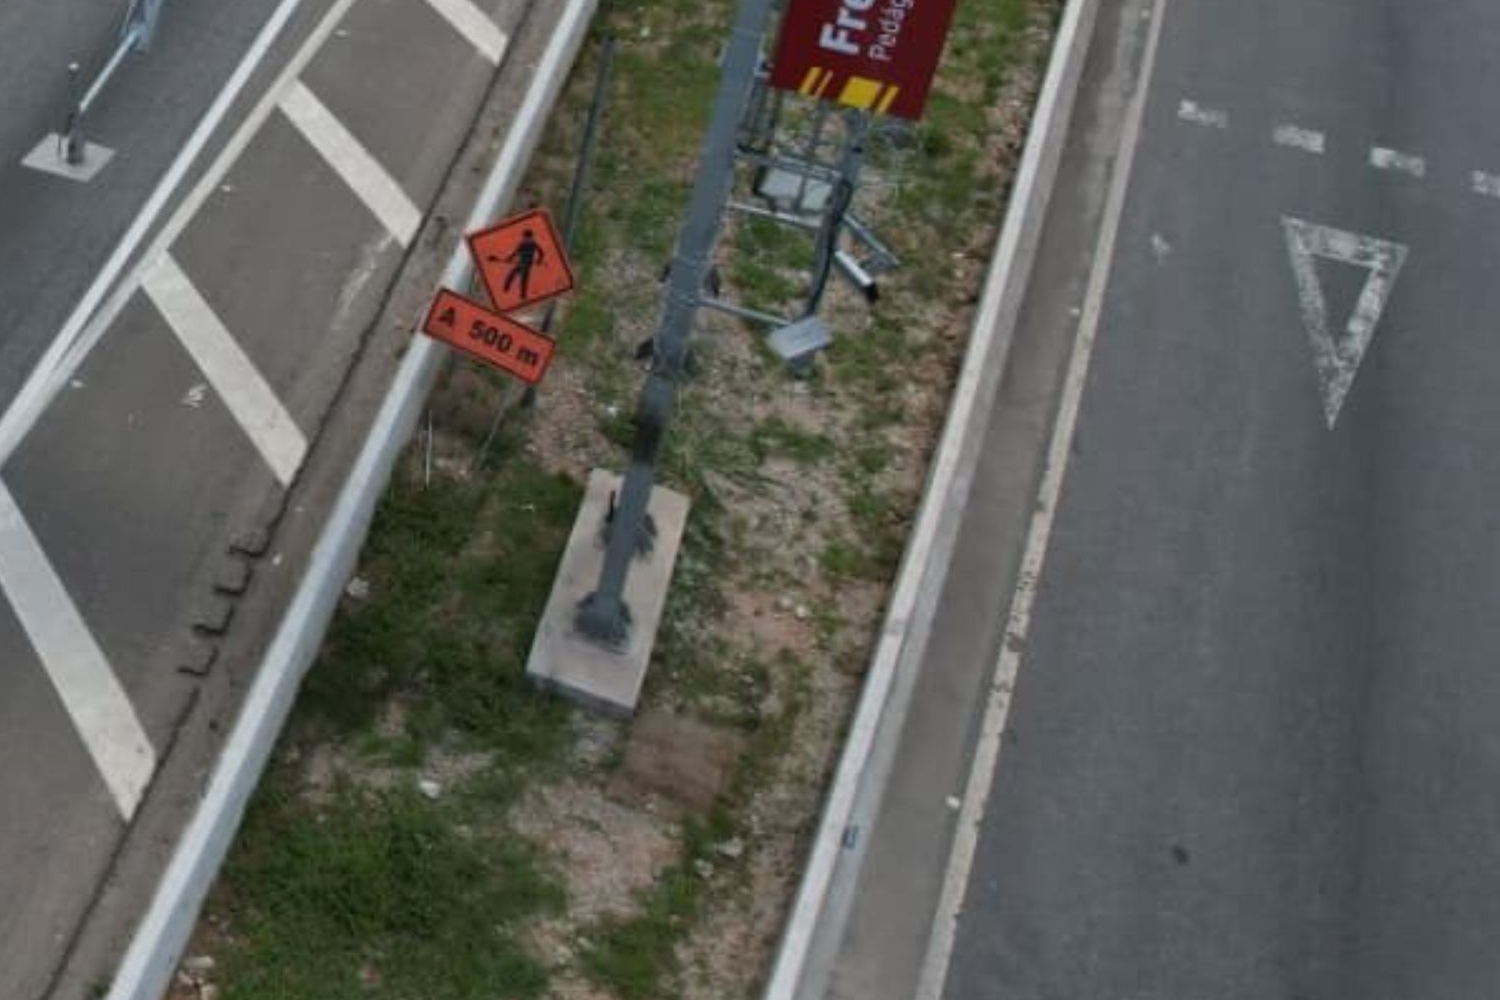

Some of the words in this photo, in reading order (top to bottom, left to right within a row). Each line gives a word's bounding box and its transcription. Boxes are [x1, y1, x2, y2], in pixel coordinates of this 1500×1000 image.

[438, 307, 455, 327] A
[470, 320, 513, 351] 500
[515, 346, 539, 366] m
